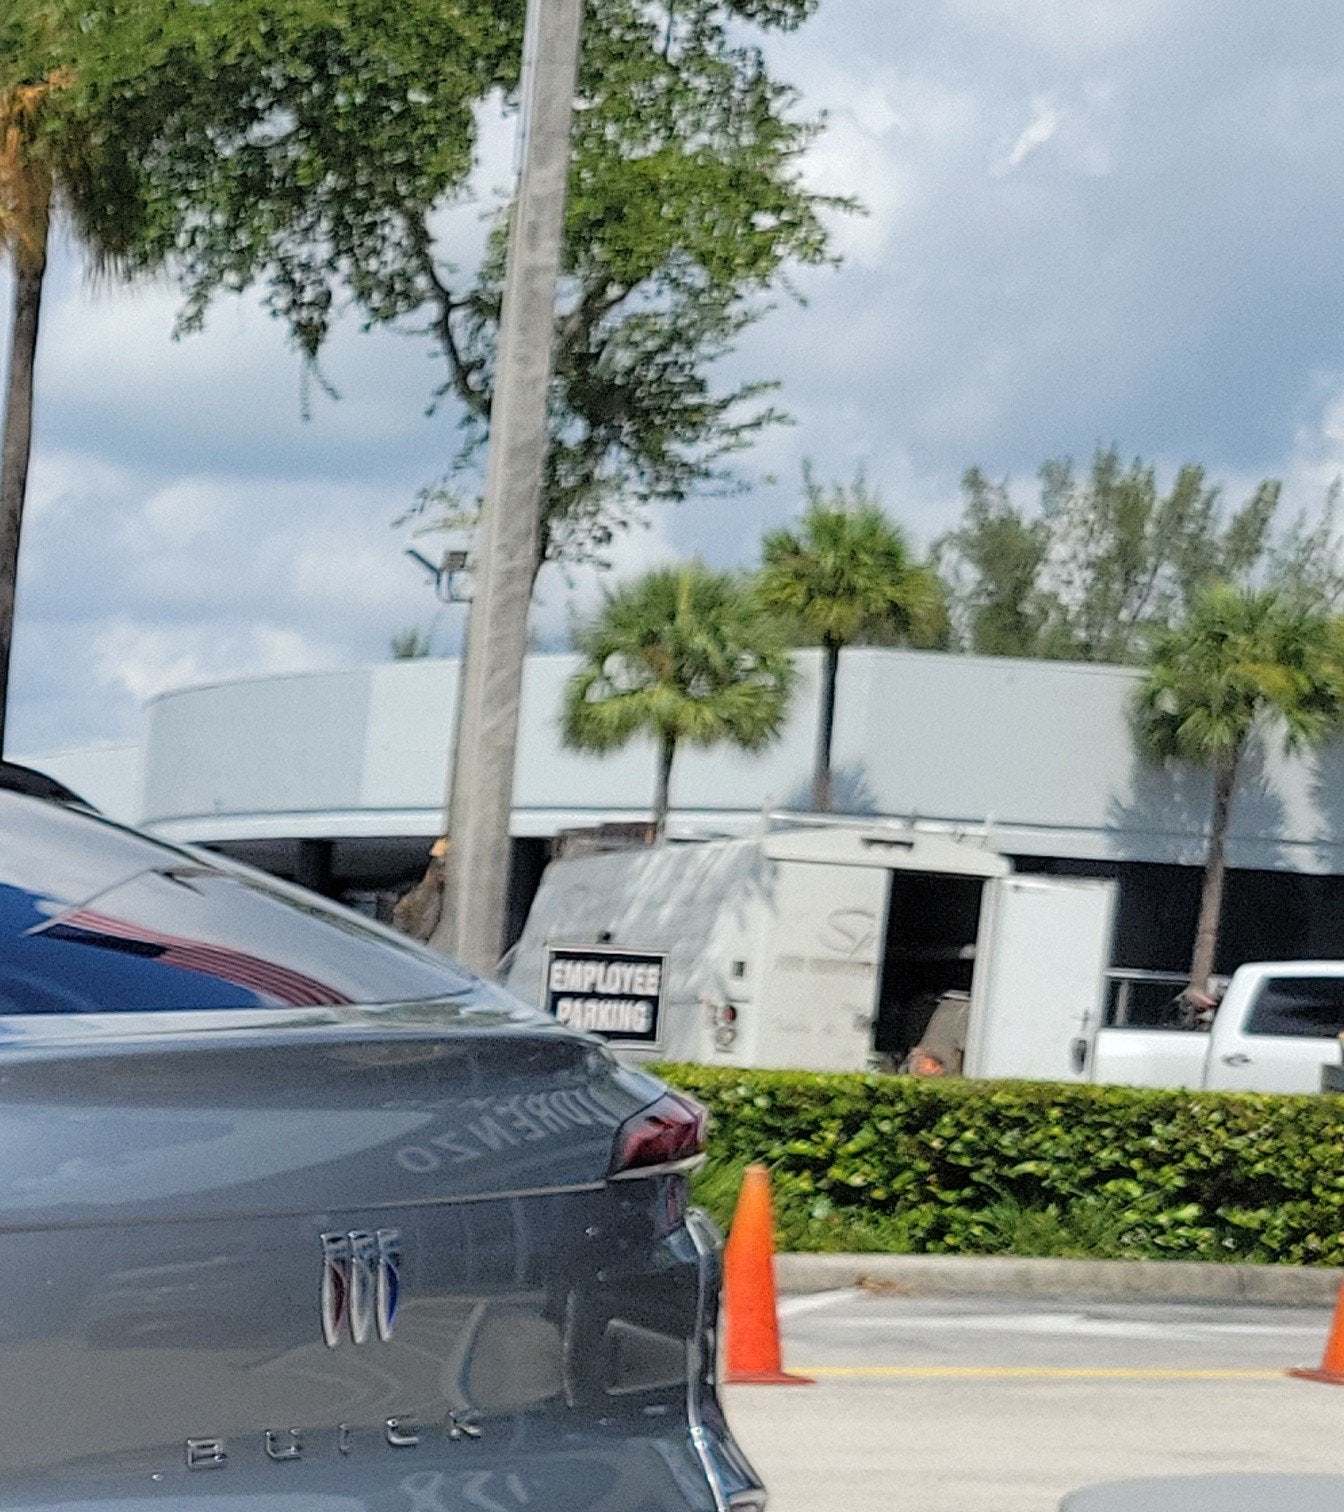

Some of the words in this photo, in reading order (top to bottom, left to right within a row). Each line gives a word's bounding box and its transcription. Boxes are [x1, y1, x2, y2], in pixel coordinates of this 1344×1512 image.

[550, 958, 661, 996] EMPLOYEE
[556, 996, 653, 1033] PARKING
[185, 1408, 483, 1472] BUICK
